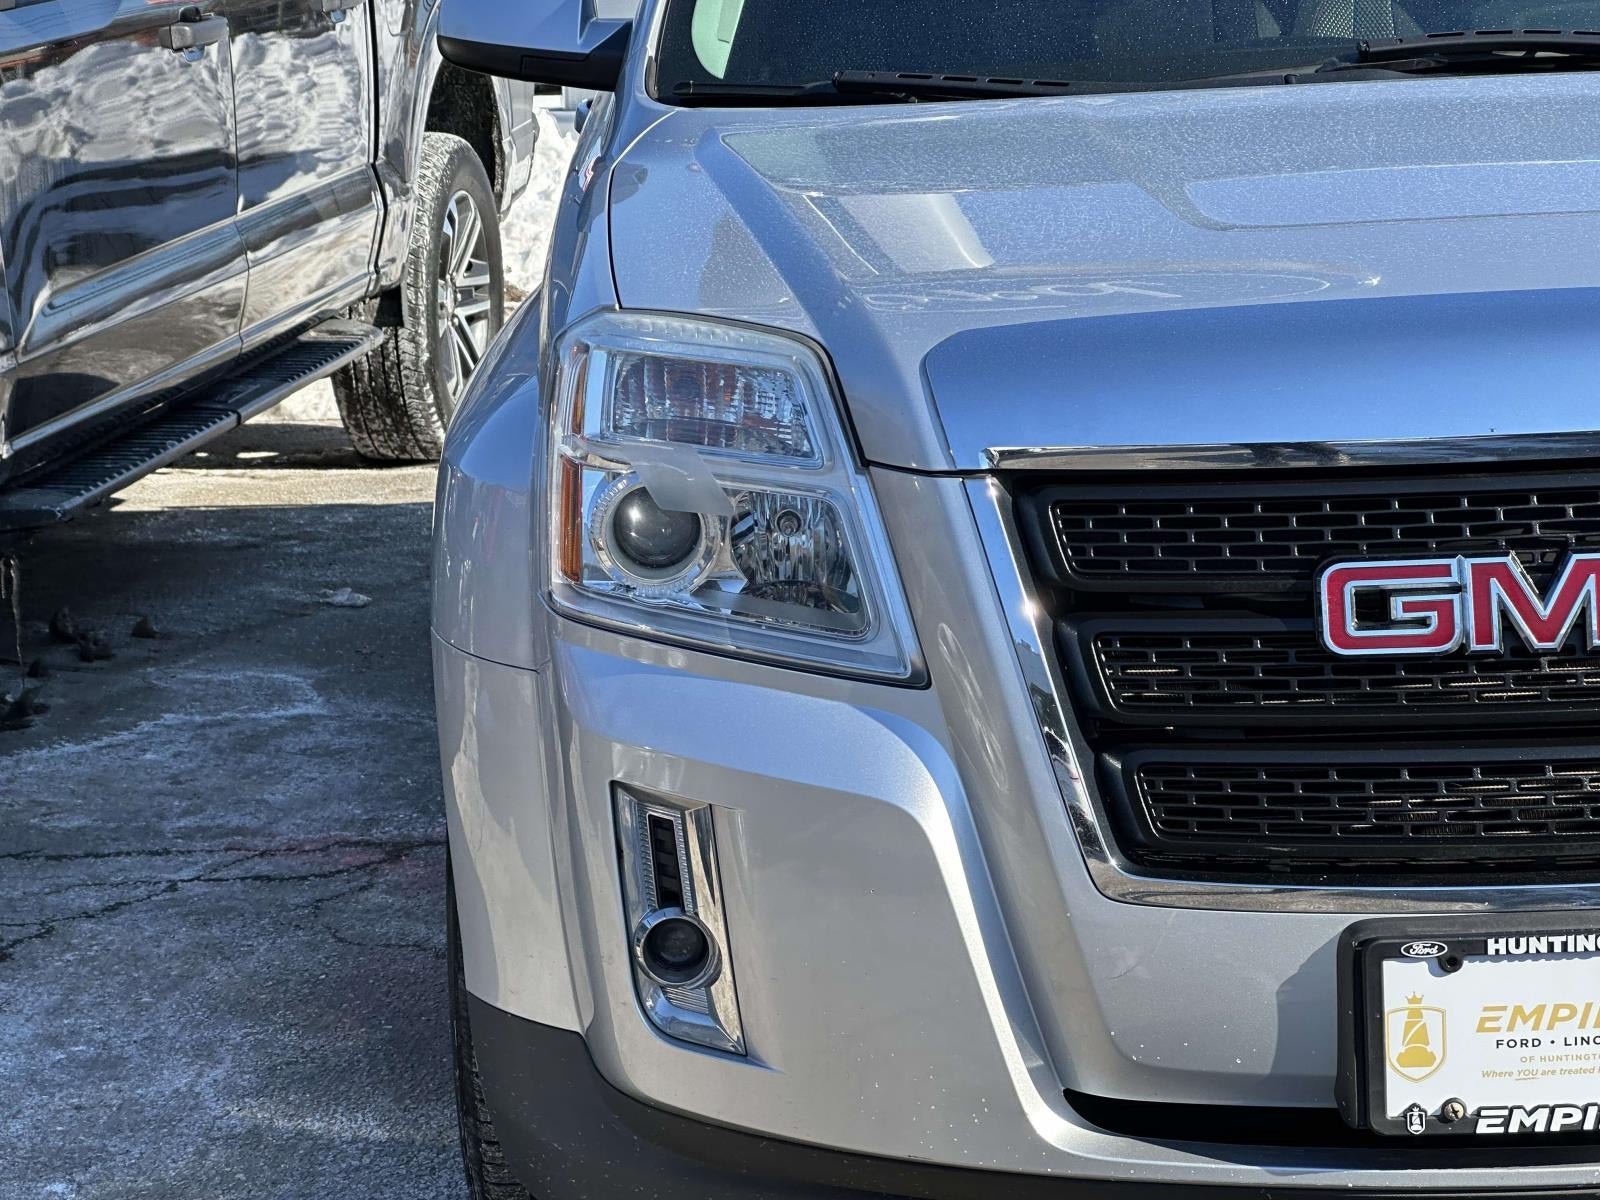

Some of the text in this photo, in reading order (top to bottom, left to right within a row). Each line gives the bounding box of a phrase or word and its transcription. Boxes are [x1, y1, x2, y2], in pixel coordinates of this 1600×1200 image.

[1320, 553, 1600, 656] GM
[1409, 943, 1439, 955] Ford
[1487, 933, 1600, 956] HUNTIN
[1475, 1001, 1600, 1033] EMPI
[1496, 1038, 1542, 1049] FORD
[1520, 1053, 1600, 1063] OF HUNTINGT
[1482, 1069, 1514, 1078] Where
[1517, 1068, 1539, 1077] YOU
[1560, 1066, 1595, 1076] treated
[1475, 1105, 1600, 1134] EMPI
